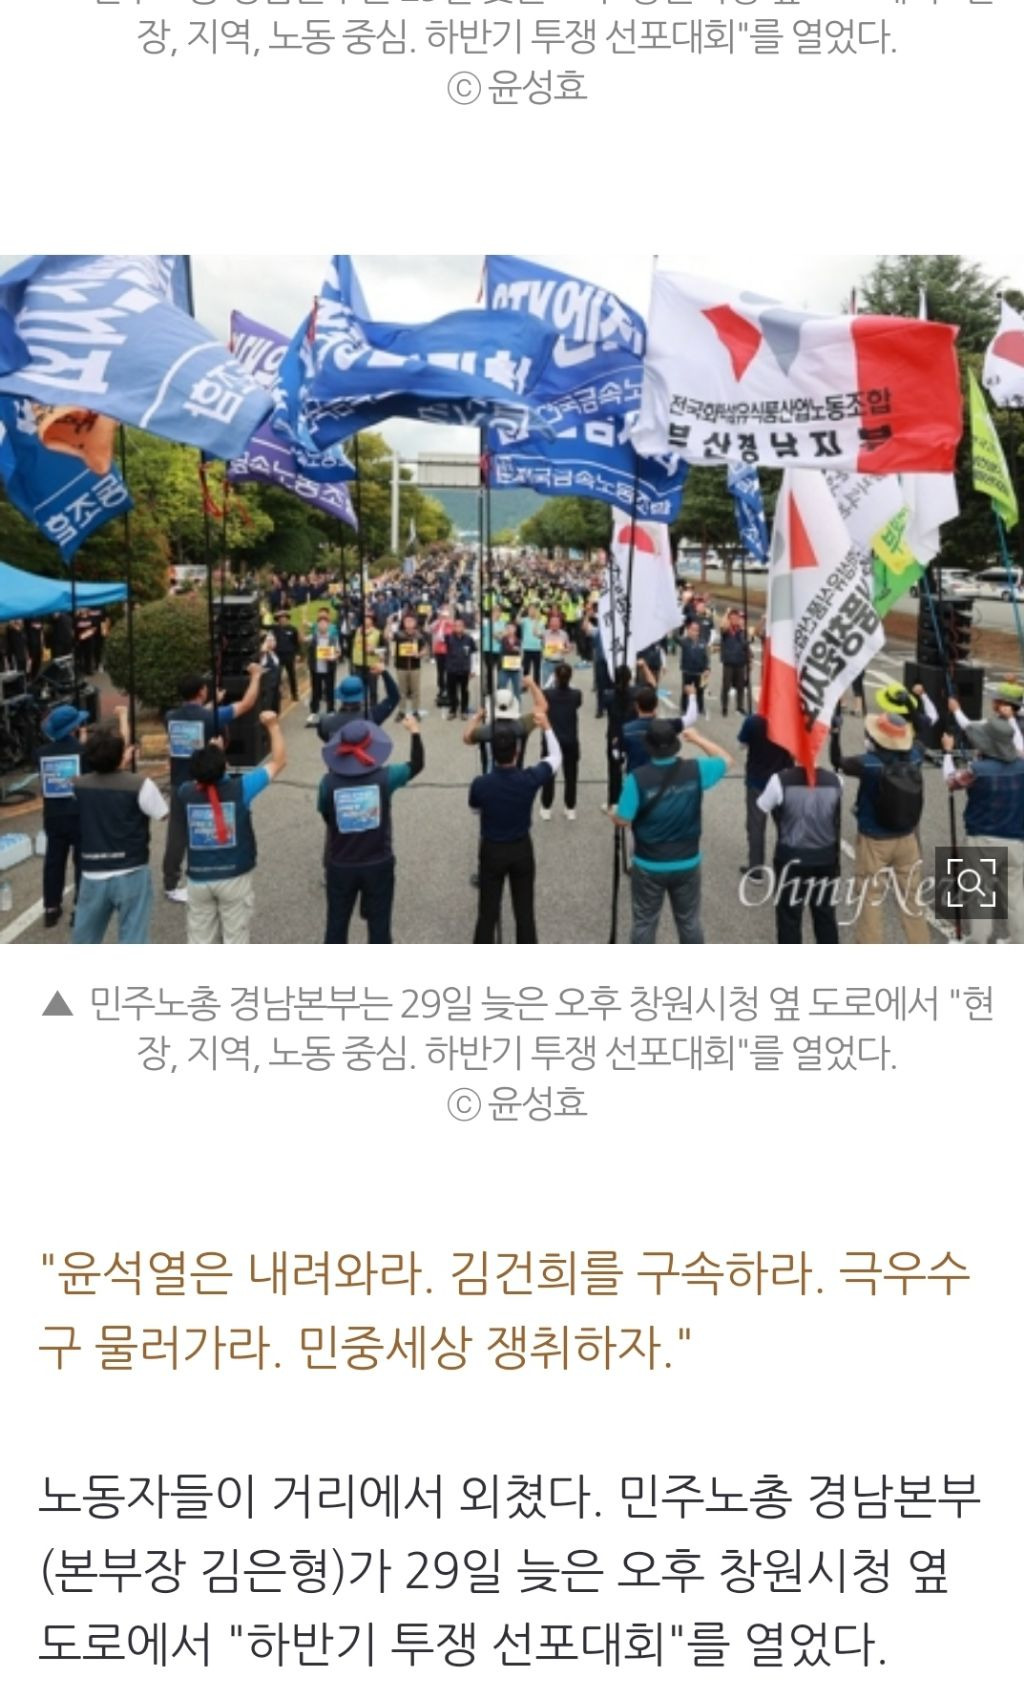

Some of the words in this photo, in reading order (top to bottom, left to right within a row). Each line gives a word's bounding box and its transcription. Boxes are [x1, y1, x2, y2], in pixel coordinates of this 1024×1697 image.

[137, 18, 178, 57] 장,
[187, 18, 261, 57] 지역,
[268, 18, 336, 57] 노동
[341, 18, 416, 57] 중심.
[424, 18, 521, 57] 하반기
[530, 18, 596, 57] 투쟁
[605, 18, 785, 57] 선포대회"를
[792, 18, 897, 57] 열었다.
[487, 68, 589, 106] 윤성효
[91, 985, 222, 1023] 민주노총
[230, 985, 394, 1023] 경남본부는
[400, 985, 472, 1023] 29일
[480, 985, 549, 1023] 늦은
[554, 985, 623, 1023] 오후
[629, 985, 758, 1023] 창원시청
[769, 985, 801, 1023] 옆
[807, 985, 938, 1023] 도로에서
[950, 985, 994, 1023] "현
[137, 1035, 178, 1074] 장,
[187, 1035, 261, 1074] 지역,
[268, 1035, 336, 1074] 노동
[341, 1035, 416, 1074] 중심.
[424, 1035, 521, 1074] 하반기
[530, 1035, 596, 1074] 투쟁
[605, 1035, 785, 1074] 선포대회"를
[792, 1035, 897, 1074] 열었다.
[487, 1085, 589, 1123] 윤성효
[42, 1250, 234, 1297] "윤석열은
[250, 1250, 433, 1297] 내려와라.
[451, 1250, 625, 1297] 김건희를
[636, 1250, 824, 1297] 구속하라.
[839, 1250, 971, 1297] 극우수
[38, 1324, 82, 1371] 구
[94, 1324, 281, 1371] 물러가라.
[300, 1324, 474, 1371] 민중세상
[487, 1324, 691, 1371] 쟁취하자."
[38, 1473, 253, 1520] 노동자들이
[273, 1473, 442, 1520] 거리에서
[459, 1473, 602, 1520] 외쳤다.
[621, 1473, 793, 1520] 민주노총
[808, 1473, 982, 1520] 경남본부
[42, 1547, 187, 1596] (본부장
[202, 1547, 393, 1596] 김은형)가
[405, 1547, 501, 1596] 29일
[516, 1547, 605, 1596] 늦은
[616, 1547, 706, 1596] 오후
[719, 1547, 890, 1596] 창원시청
[909, 1547, 949, 1596] 옆
[38, 1621, 209, 1668] 도로에서
[230, 1621, 374, 1668] "하반기
[390, 1621, 476, 1668] 투쟁
[492, 1621, 731, 1668] 선포대회"를
[746, 1621, 886, 1668] 열었다.
